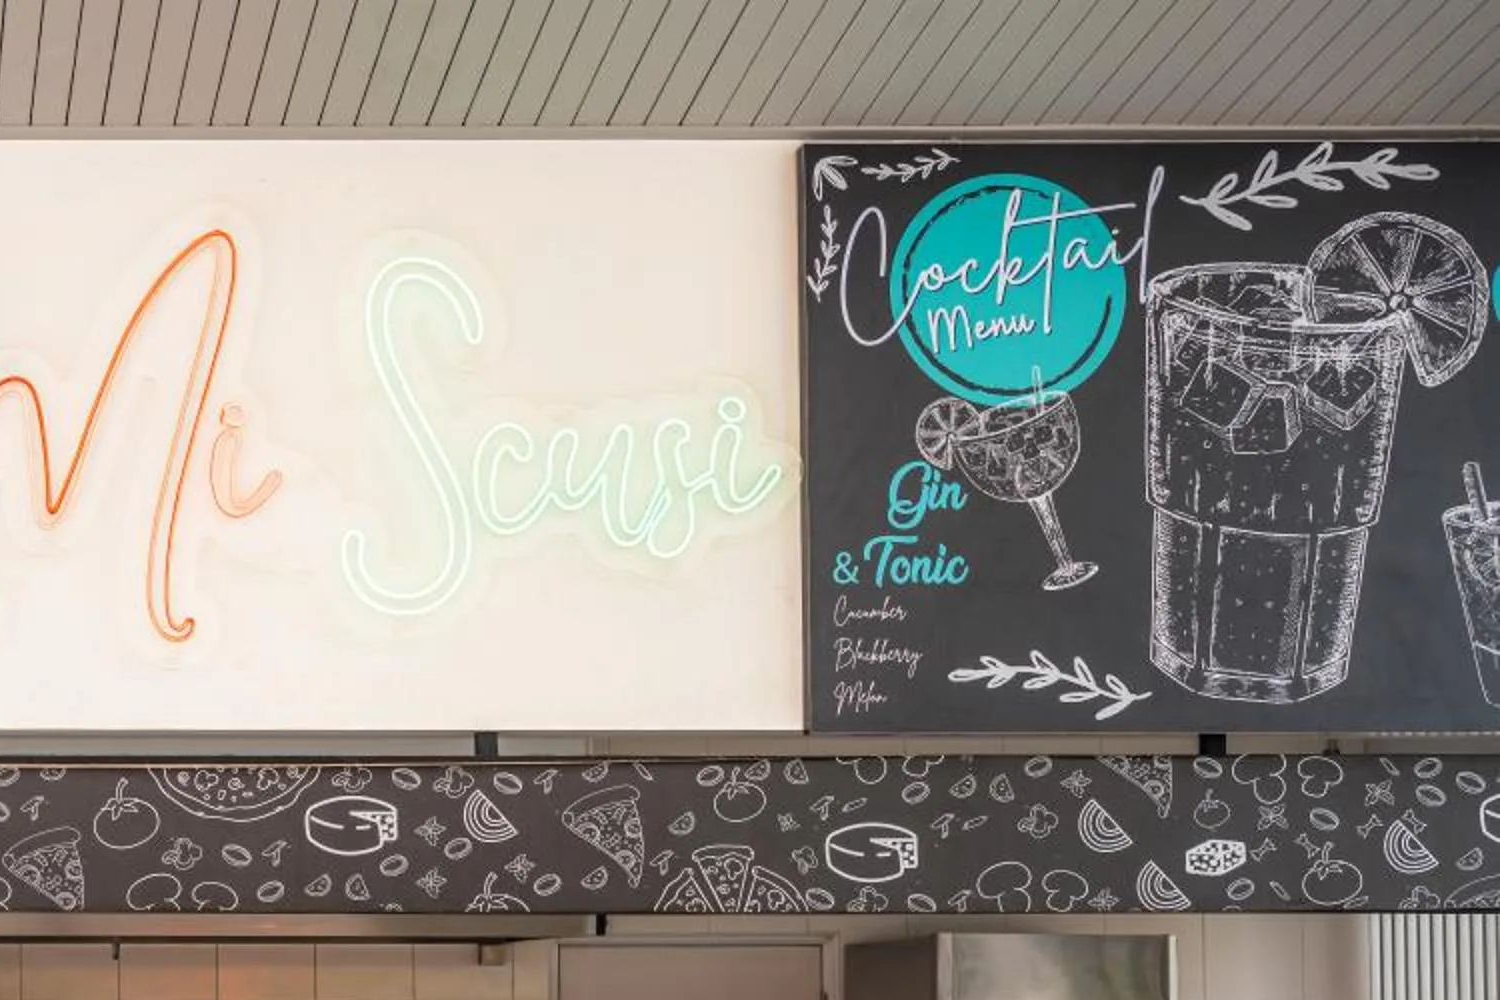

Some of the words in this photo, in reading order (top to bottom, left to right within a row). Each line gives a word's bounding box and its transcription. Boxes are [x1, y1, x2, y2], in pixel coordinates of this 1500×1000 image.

[840, 165, 1165, 347] Cocktail
[928, 304, 1036, 353] Menu
[340, 256, 783, 616] Scusi
[887, 460, 968, 530] Gin
[833, 552, 859, 584] &
[863, 535, 969, 589] Tonic
